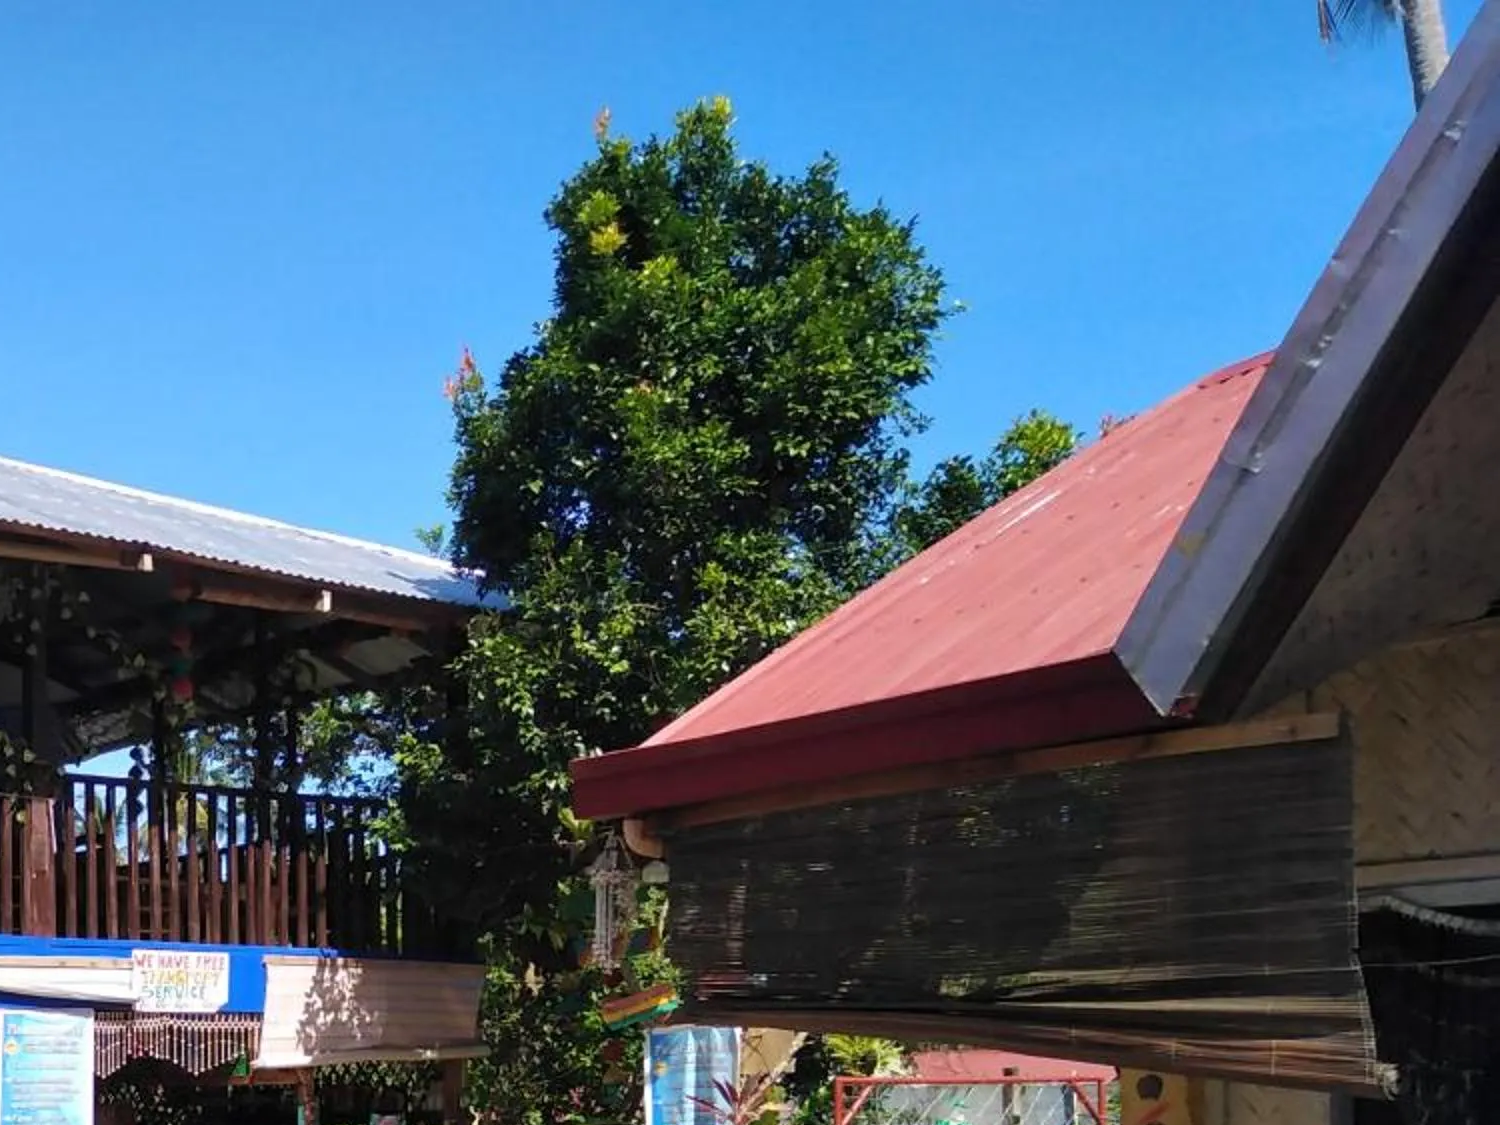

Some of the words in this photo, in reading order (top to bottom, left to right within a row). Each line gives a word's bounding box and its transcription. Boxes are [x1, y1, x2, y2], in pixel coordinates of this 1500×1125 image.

[134, 952, 153, 968] WE
[158, 954, 191, 968] HAVE
[141, 985, 206, 999] SERVICE
